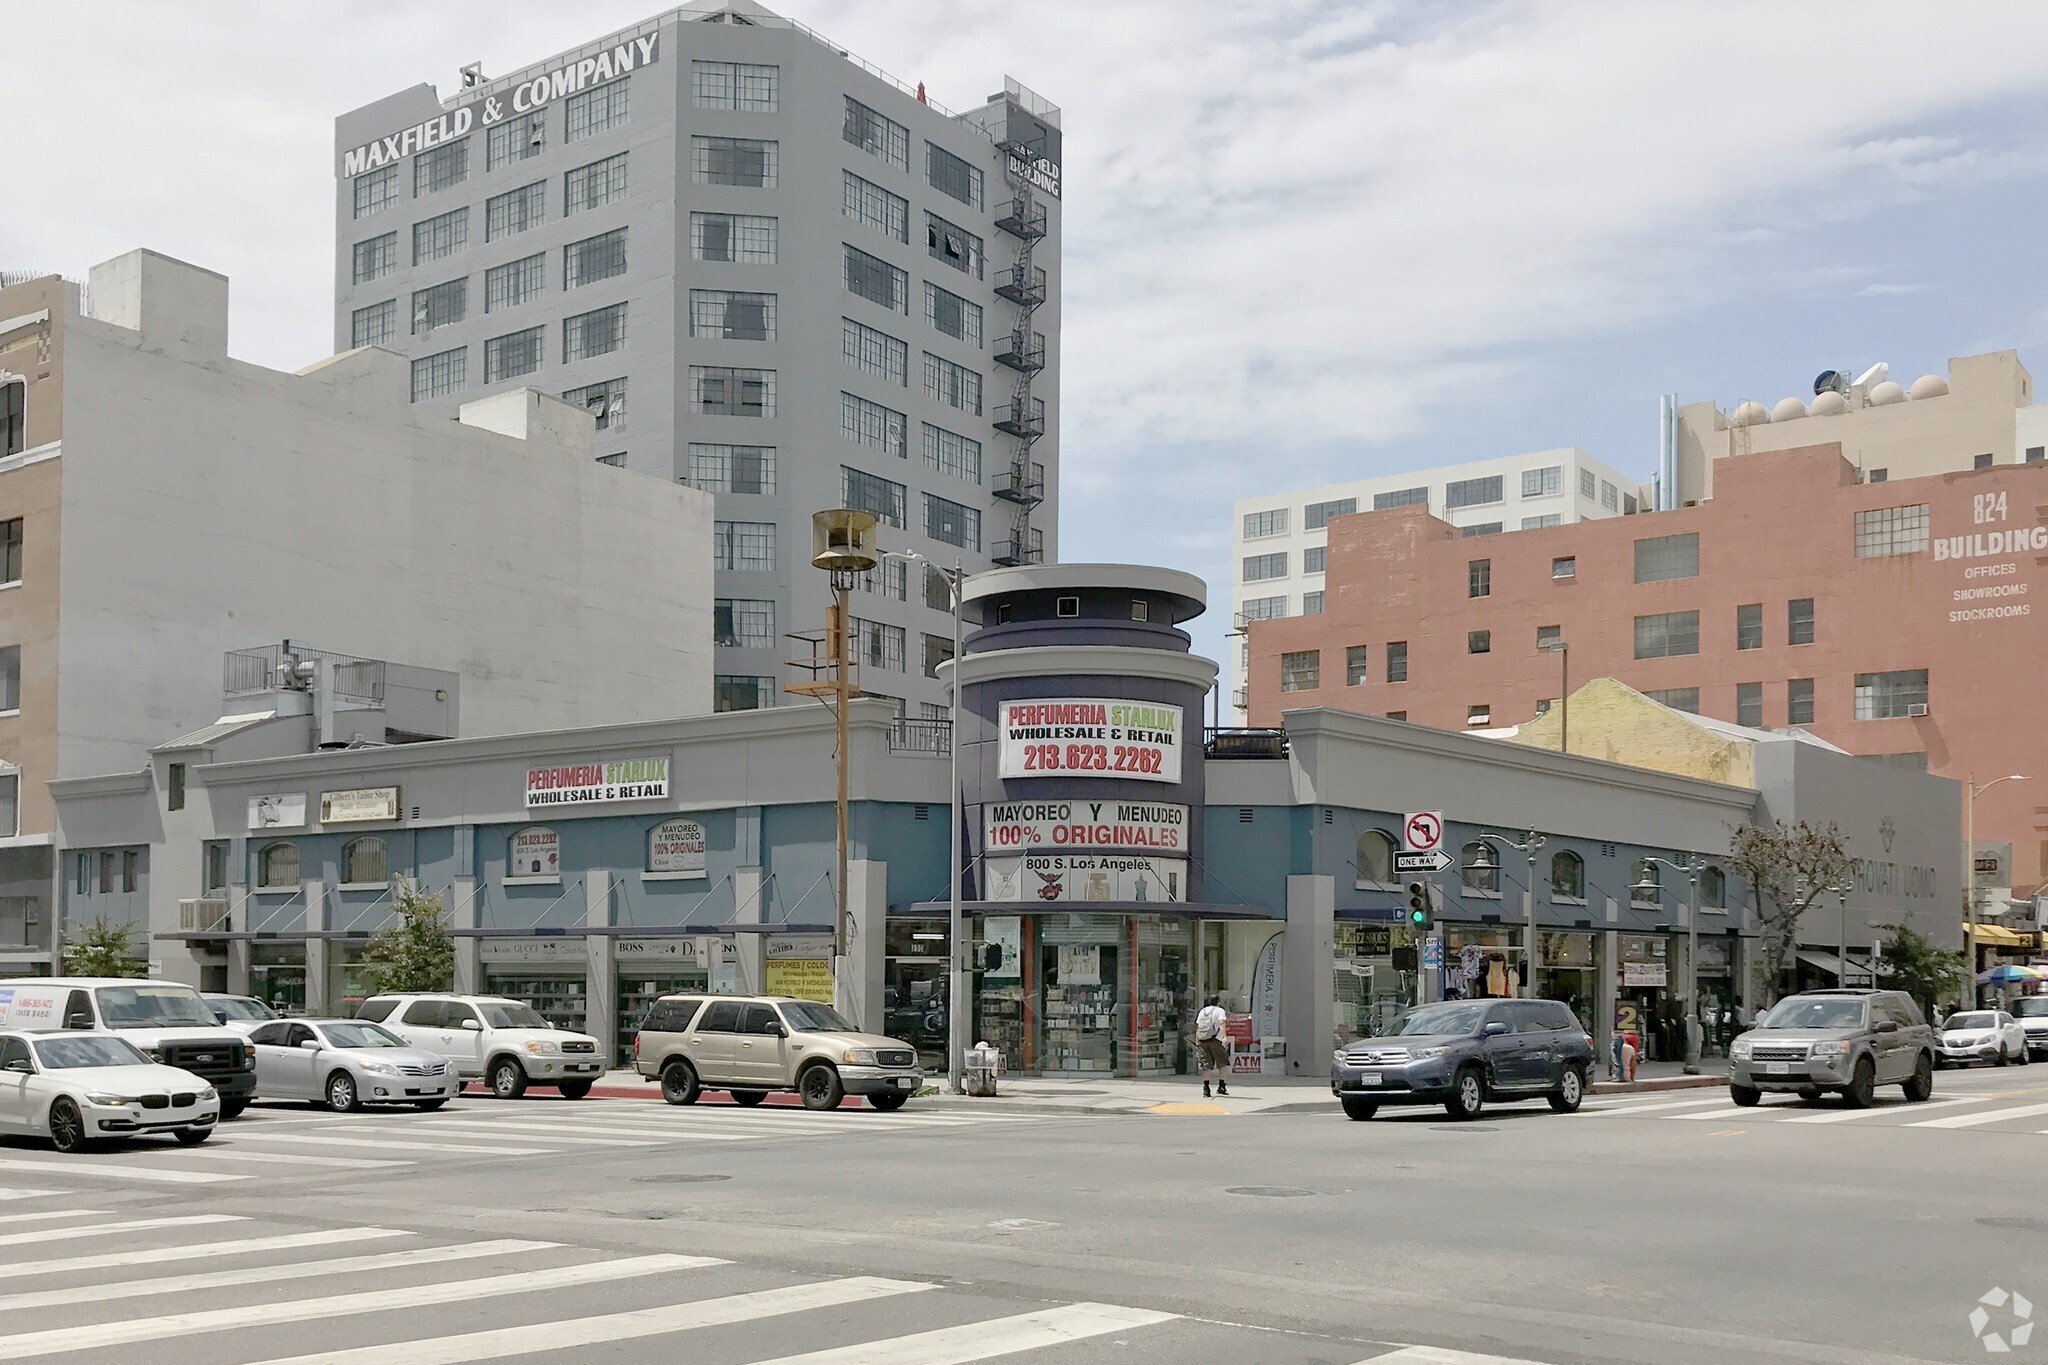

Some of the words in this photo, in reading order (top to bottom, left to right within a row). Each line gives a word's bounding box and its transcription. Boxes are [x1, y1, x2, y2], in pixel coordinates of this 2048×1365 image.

[343, 106, 473, 179] MAXFIELD
[481, 96, 503, 126] &
[512, 31, 659, 113] COMPANY
[1973, 490, 2008, 525] 824
[1934, 526, 2048, 562] BUILDING
[1964, 562, 2017, 579] OFFICES
[1953, 583, 2028, 601] SHOWROOMS
[1948, 603, 2031, 622] STOCKROOMS
[1008, 703, 1107, 726] PERFUMERIA
[1111, 704, 1176, 732] STARLUX
[1009, 727, 1106, 740] WHOLESALE
[1110, 728, 1123, 740] &
[1127, 730, 1175, 746] RETAIL
[1023, 743, 1163, 775] 213.623.2262
[527, 764, 604, 791] PERFUMERIA
[606, 758, 667, 785] STARLUX
[374, 789, 390, 800] Shop
[527, 787, 603, 805] WHOLESALE
[606, 787, 615, 799] &
[619, 783, 666, 799] RETAIL
[993, 803, 1072, 823] MAYOREO
[1089, 802, 1103, 822] Y
[1117, 804, 1182, 825] MENUDEO
[661, 823, 698, 833] MAYOREO
[664, 832, 701, 842] MENUDEO
[989, 825, 1042, 846] 100%
[1051, 824, 1178, 848] ORIGINALES
[669, 840, 705, 856] ORIGINALES
[1026, 858, 1049, 870] 800
[1054, 857, 1067, 870] S.
[1070, 857, 1096, 870] Los
[1099, 858, 1151, 873] Angeles
[1400, 856, 1417, 867] ONE
[1418, 856, 1436, 866] WAY
[619, 942, 644, 953] BOSS
[766, 961, 801, 970] PERFUMES
[1617, 1006, 1637, 1029] 2
[1233, 1055, 1262, 1068] ATM
